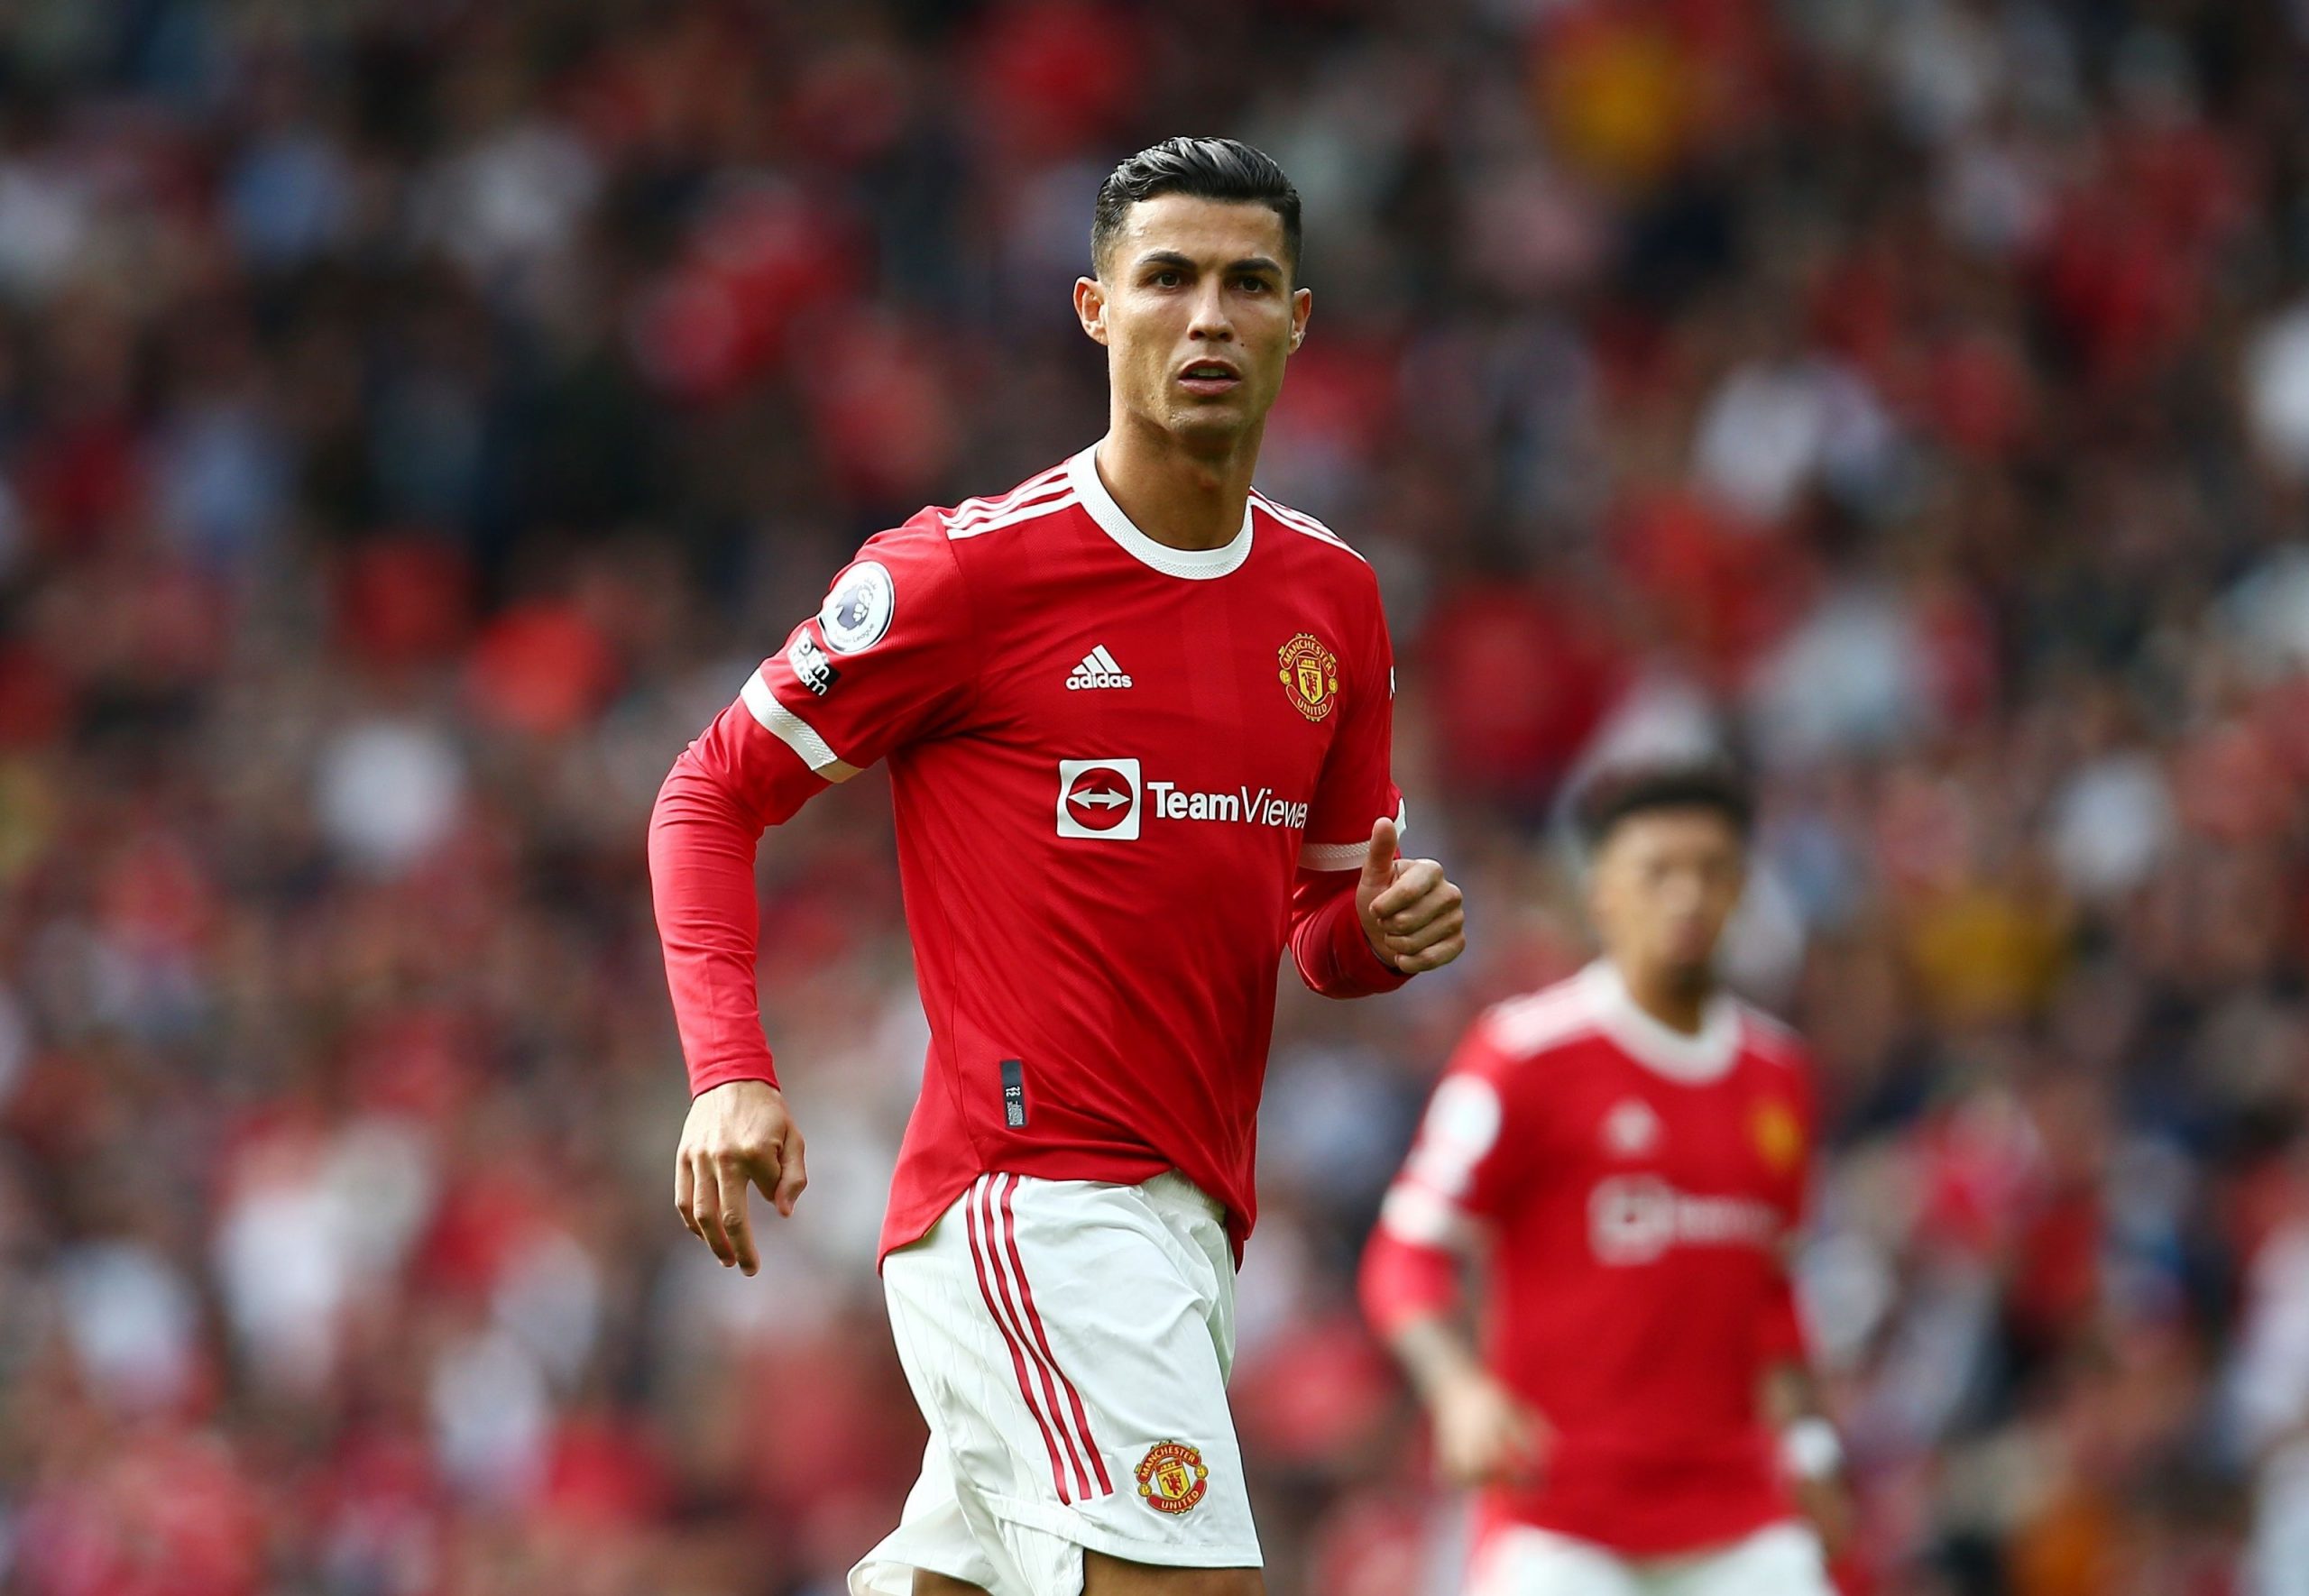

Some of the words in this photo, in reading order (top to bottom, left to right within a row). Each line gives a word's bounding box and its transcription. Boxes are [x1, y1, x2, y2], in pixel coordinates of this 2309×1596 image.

[1283, 639, 1332, 671] MANCHESTER
[1065, 672, 1133, 690] adidas
[1296, 698, 1328, 716] UNITED
[1140, 1445, 1196, 1478] MANCHESTER
[1161, 1490, 1200, 1509] UNITED
